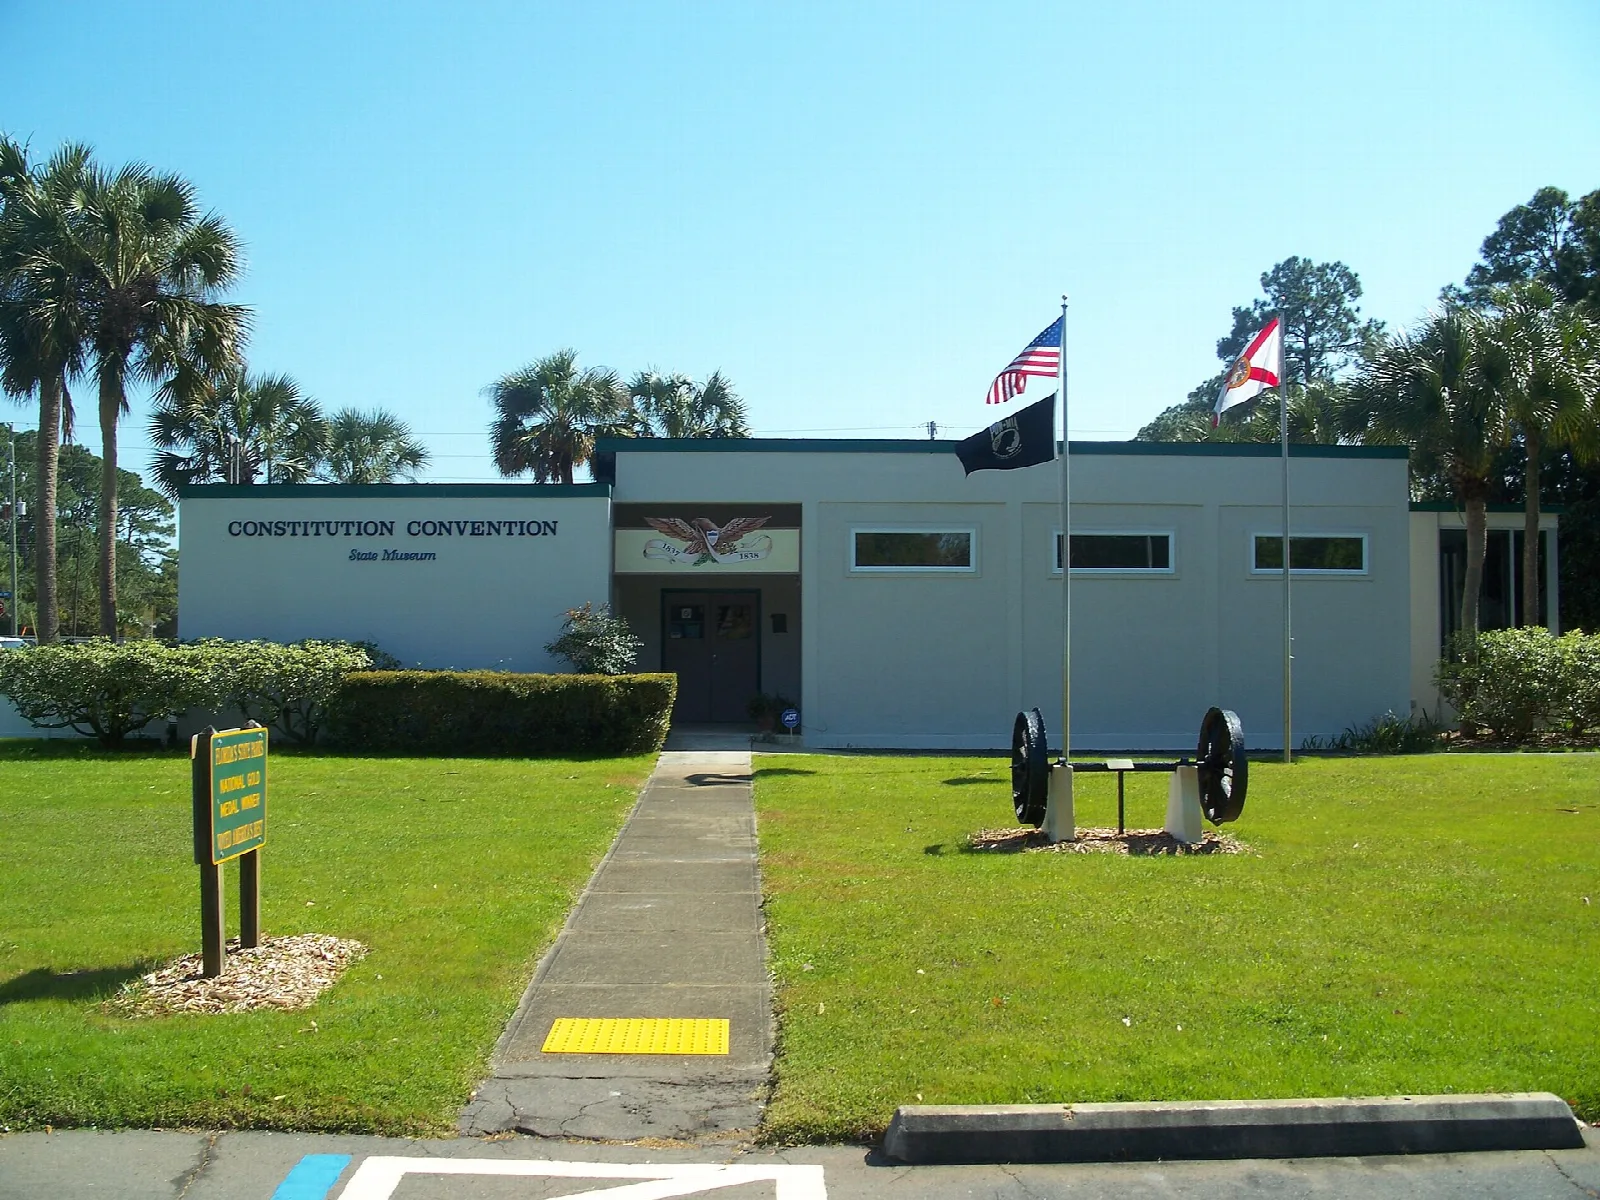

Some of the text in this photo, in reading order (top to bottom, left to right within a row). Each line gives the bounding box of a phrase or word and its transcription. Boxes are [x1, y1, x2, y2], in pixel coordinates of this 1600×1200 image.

[228, 520, 558, 537] CONSTITUTION CONVENTION
[348, 549, 437, 561] State Museum
[661, 542, 680, 557] 1837
[739, 552, 759, 560] 1838
